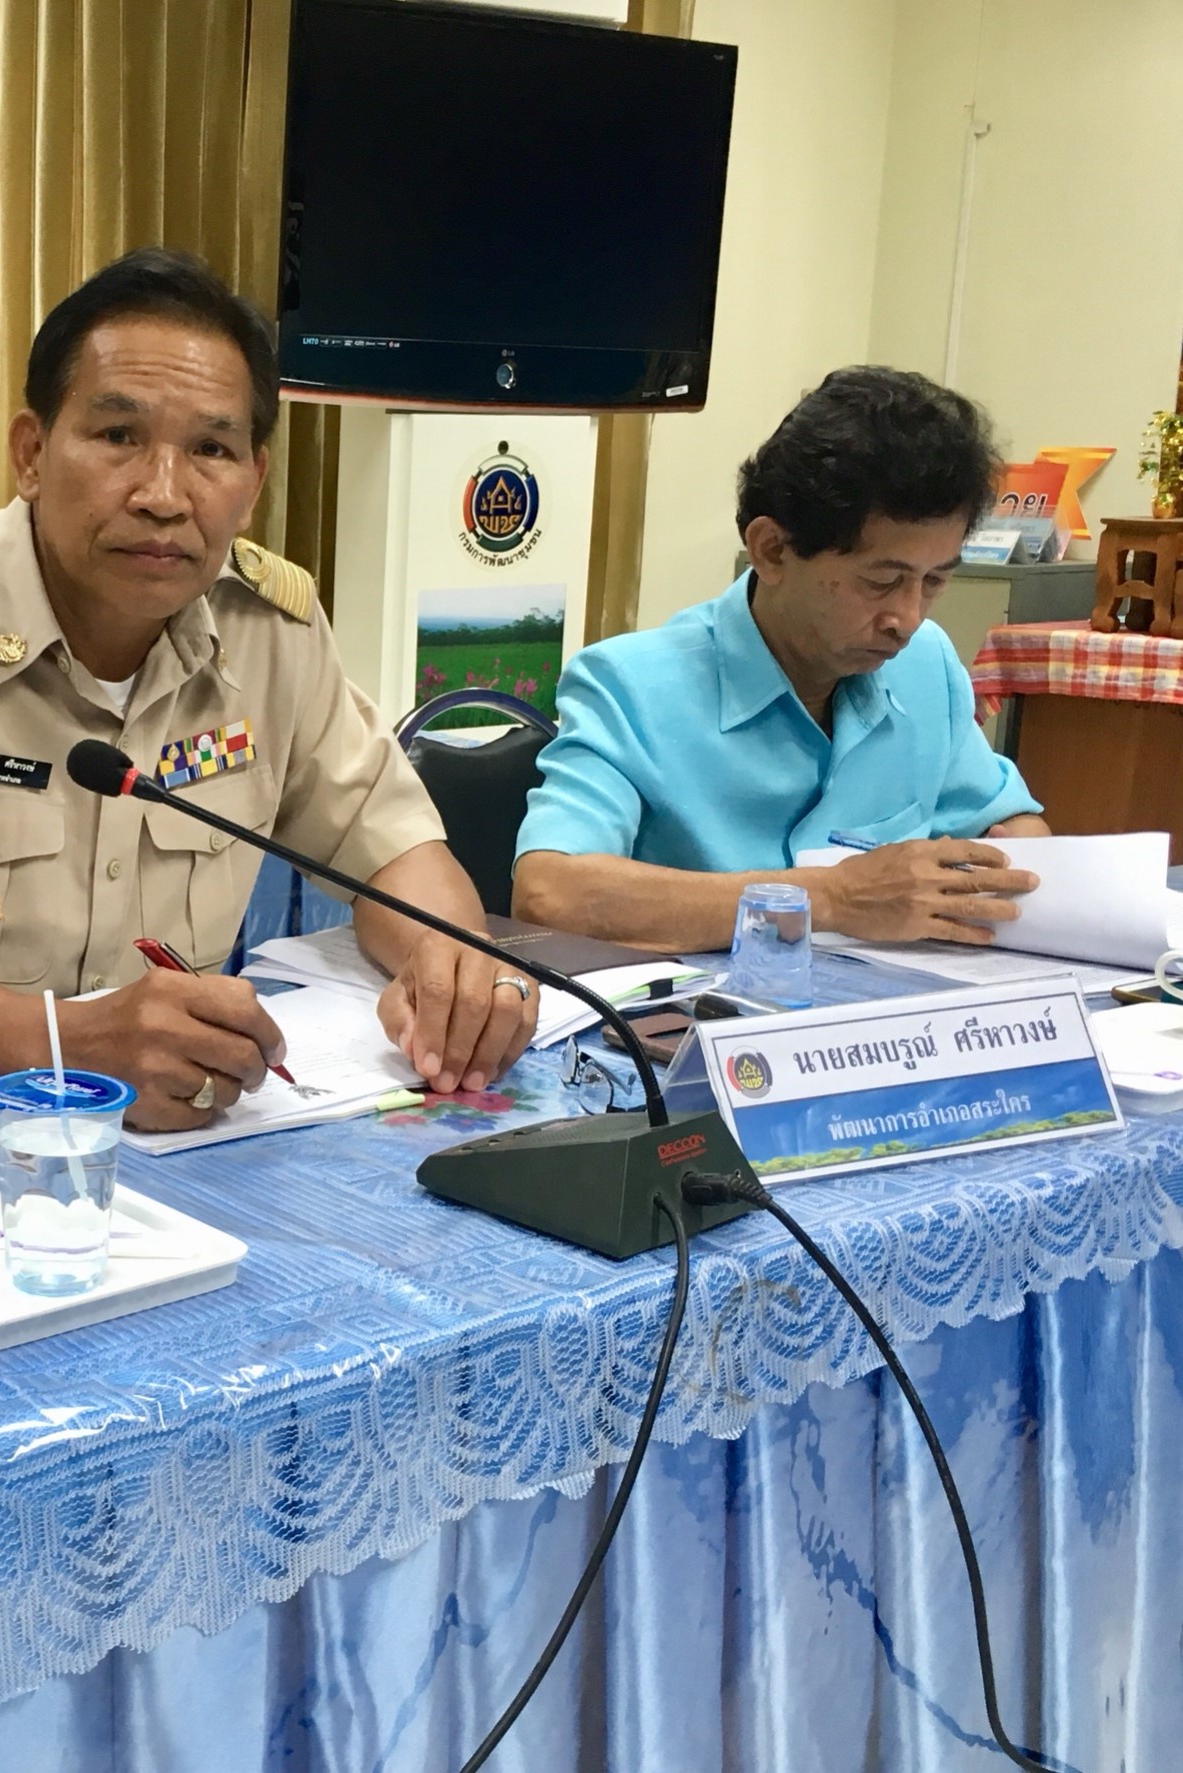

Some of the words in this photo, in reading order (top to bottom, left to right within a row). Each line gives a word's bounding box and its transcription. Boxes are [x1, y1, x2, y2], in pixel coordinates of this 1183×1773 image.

[458, 528, 543, 567] กรมการพัฒนาชุมชน
[792, 1020, 939, 1075] นายสมบรูณ์
[953, 1005, 1058, 1053] ศรีหาวงษ์
[827, 1088, 1032, 1141] พัฒนาการอำเภอสระใคร
[658, 1133, 706, 1158] DECCON
